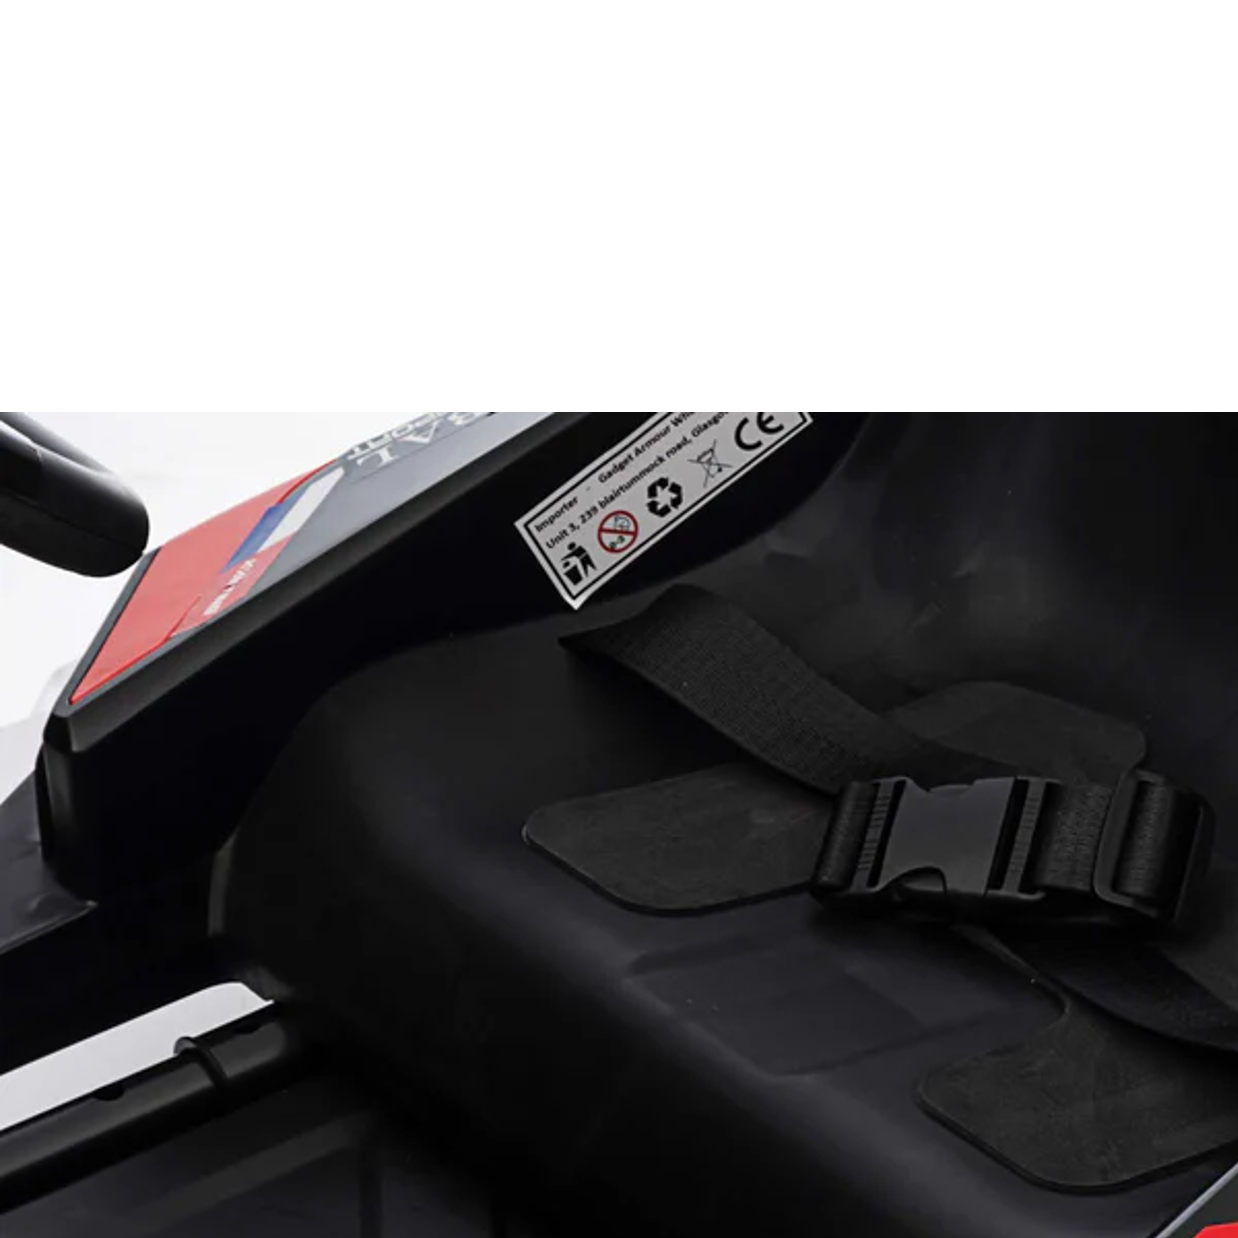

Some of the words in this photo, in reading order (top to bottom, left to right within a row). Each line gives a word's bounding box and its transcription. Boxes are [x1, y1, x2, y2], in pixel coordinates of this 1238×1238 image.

[545, 528, 569, 549] Unit
[578, 505, 599, 524] 239
[665, 436, 692, 459] road,
[691, 412, 729, 438] Glasgo
[598, 454, 634, 483] Gadget
[634, 425, 671, 457] Armour
[534, 497, 578, 533] Importer
